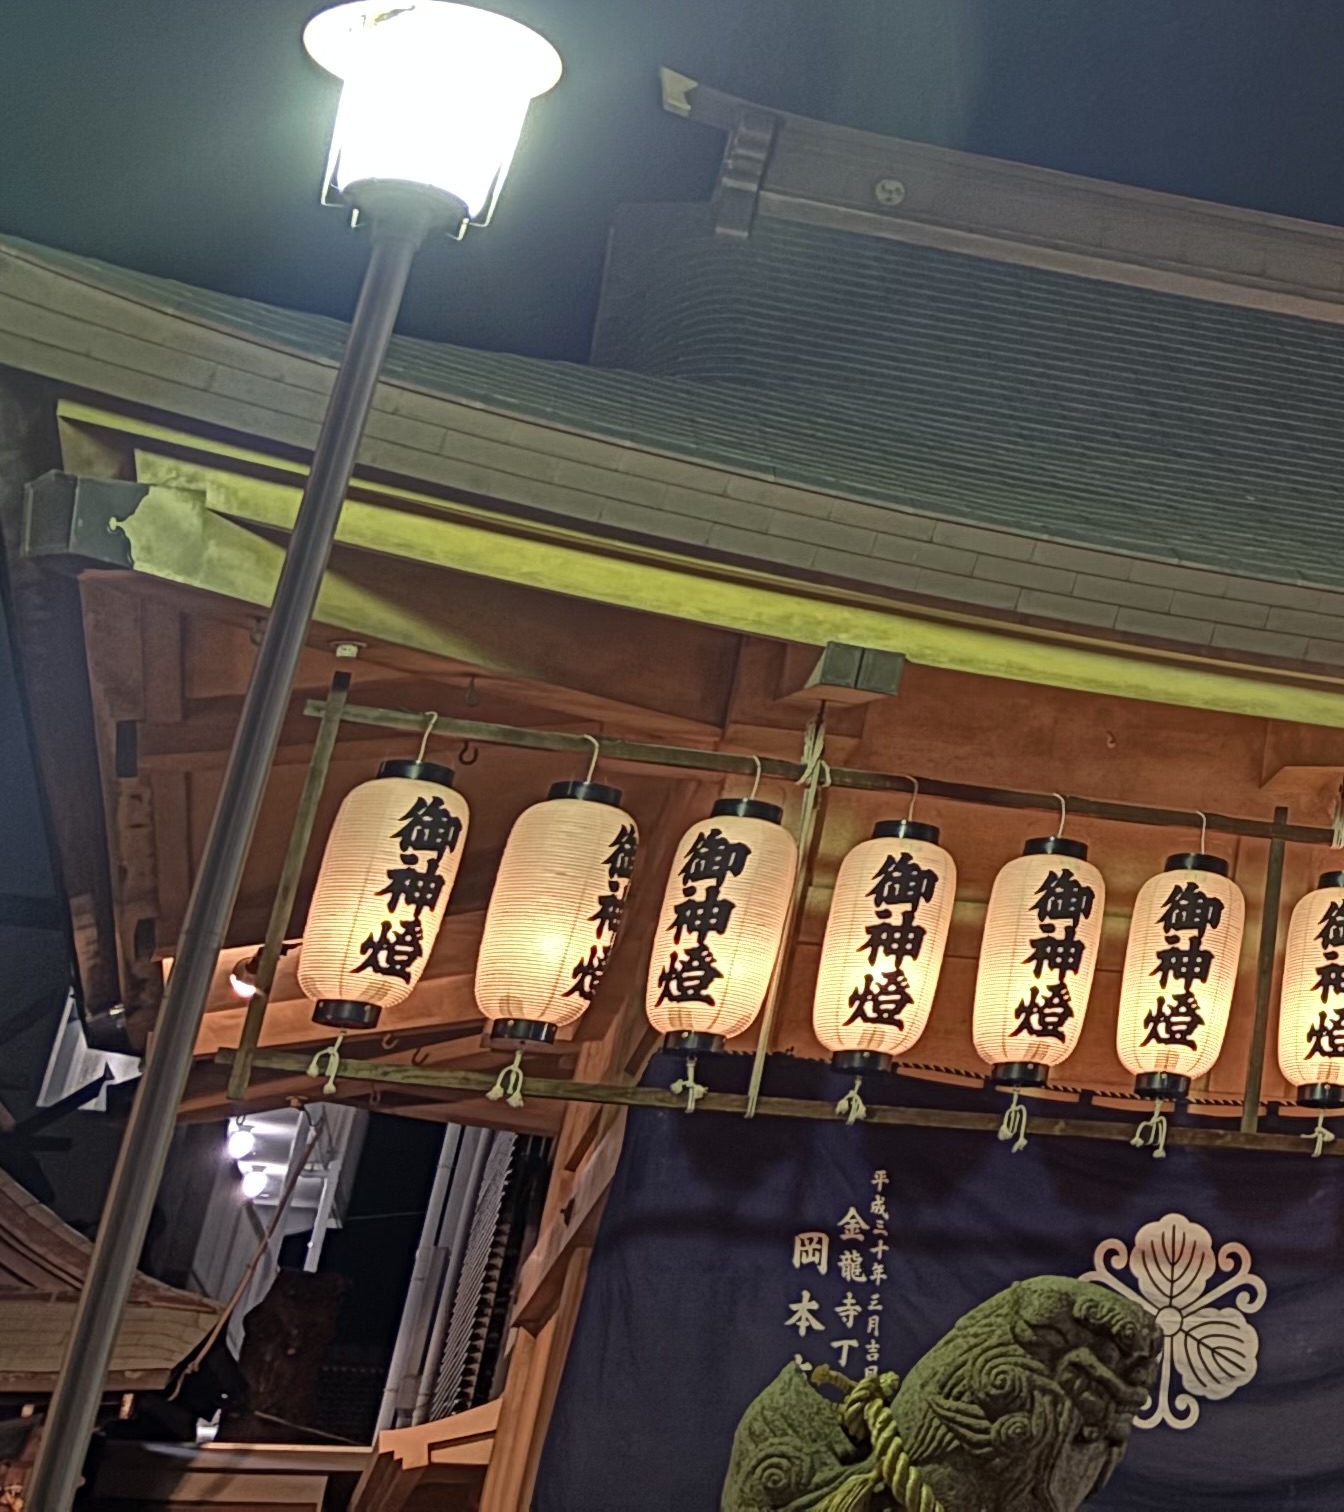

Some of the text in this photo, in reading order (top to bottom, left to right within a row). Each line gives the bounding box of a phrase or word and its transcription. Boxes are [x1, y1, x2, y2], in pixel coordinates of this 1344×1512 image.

[350, 796, 462, 984] 御神燈
[654, 827, 751, 1006] 御神燈
[843, 852, 938, 1030] 御神燈
[1010, 868, 1095, 1043] 御神燈
[1139, 881, 1224, 1051] 御神燈
[784, 1231, 830, 1371] 岡本
[830, 1206, 870, 1367] 金龍寺丁
